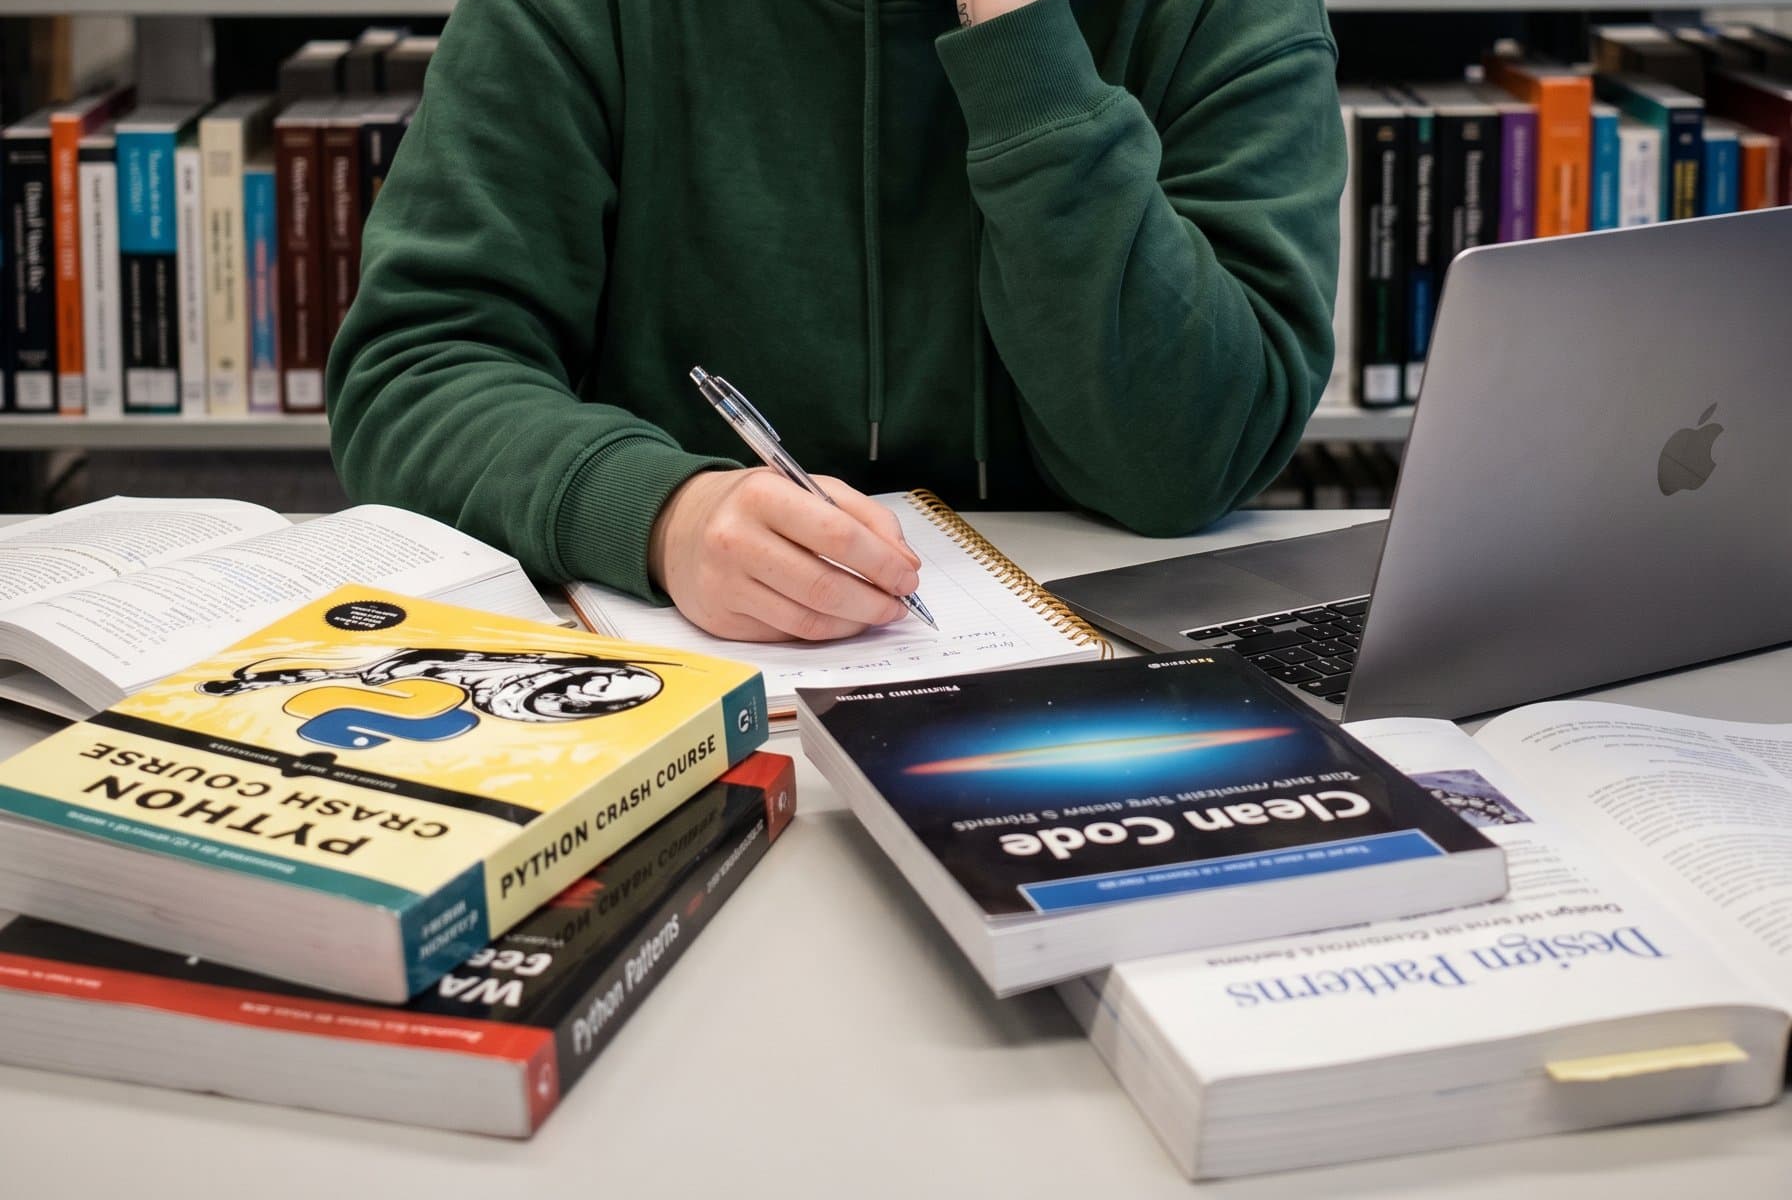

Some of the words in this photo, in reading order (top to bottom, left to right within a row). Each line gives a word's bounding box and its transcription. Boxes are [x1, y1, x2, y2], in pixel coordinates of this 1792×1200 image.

[78, 742, 272, 800] COURSE
[83, 774, 370, 857] PYTHON
[279, 790, 450, 840] CRASH
[500, 819, 588, 899] PYTHON
[595, 776, 651, 831] CRASH
[656, 734, 717, 788] COURSE
[999, 816, 1174, 861] Code
[1182, 789, 1371, 834] Clean
[1470, 925, 1667, 975] Design
[571, 970, 625, 1055] Python
[624, 910, 680, 986] Patterns
[1224, 953, 1471, 1009] Patterns
